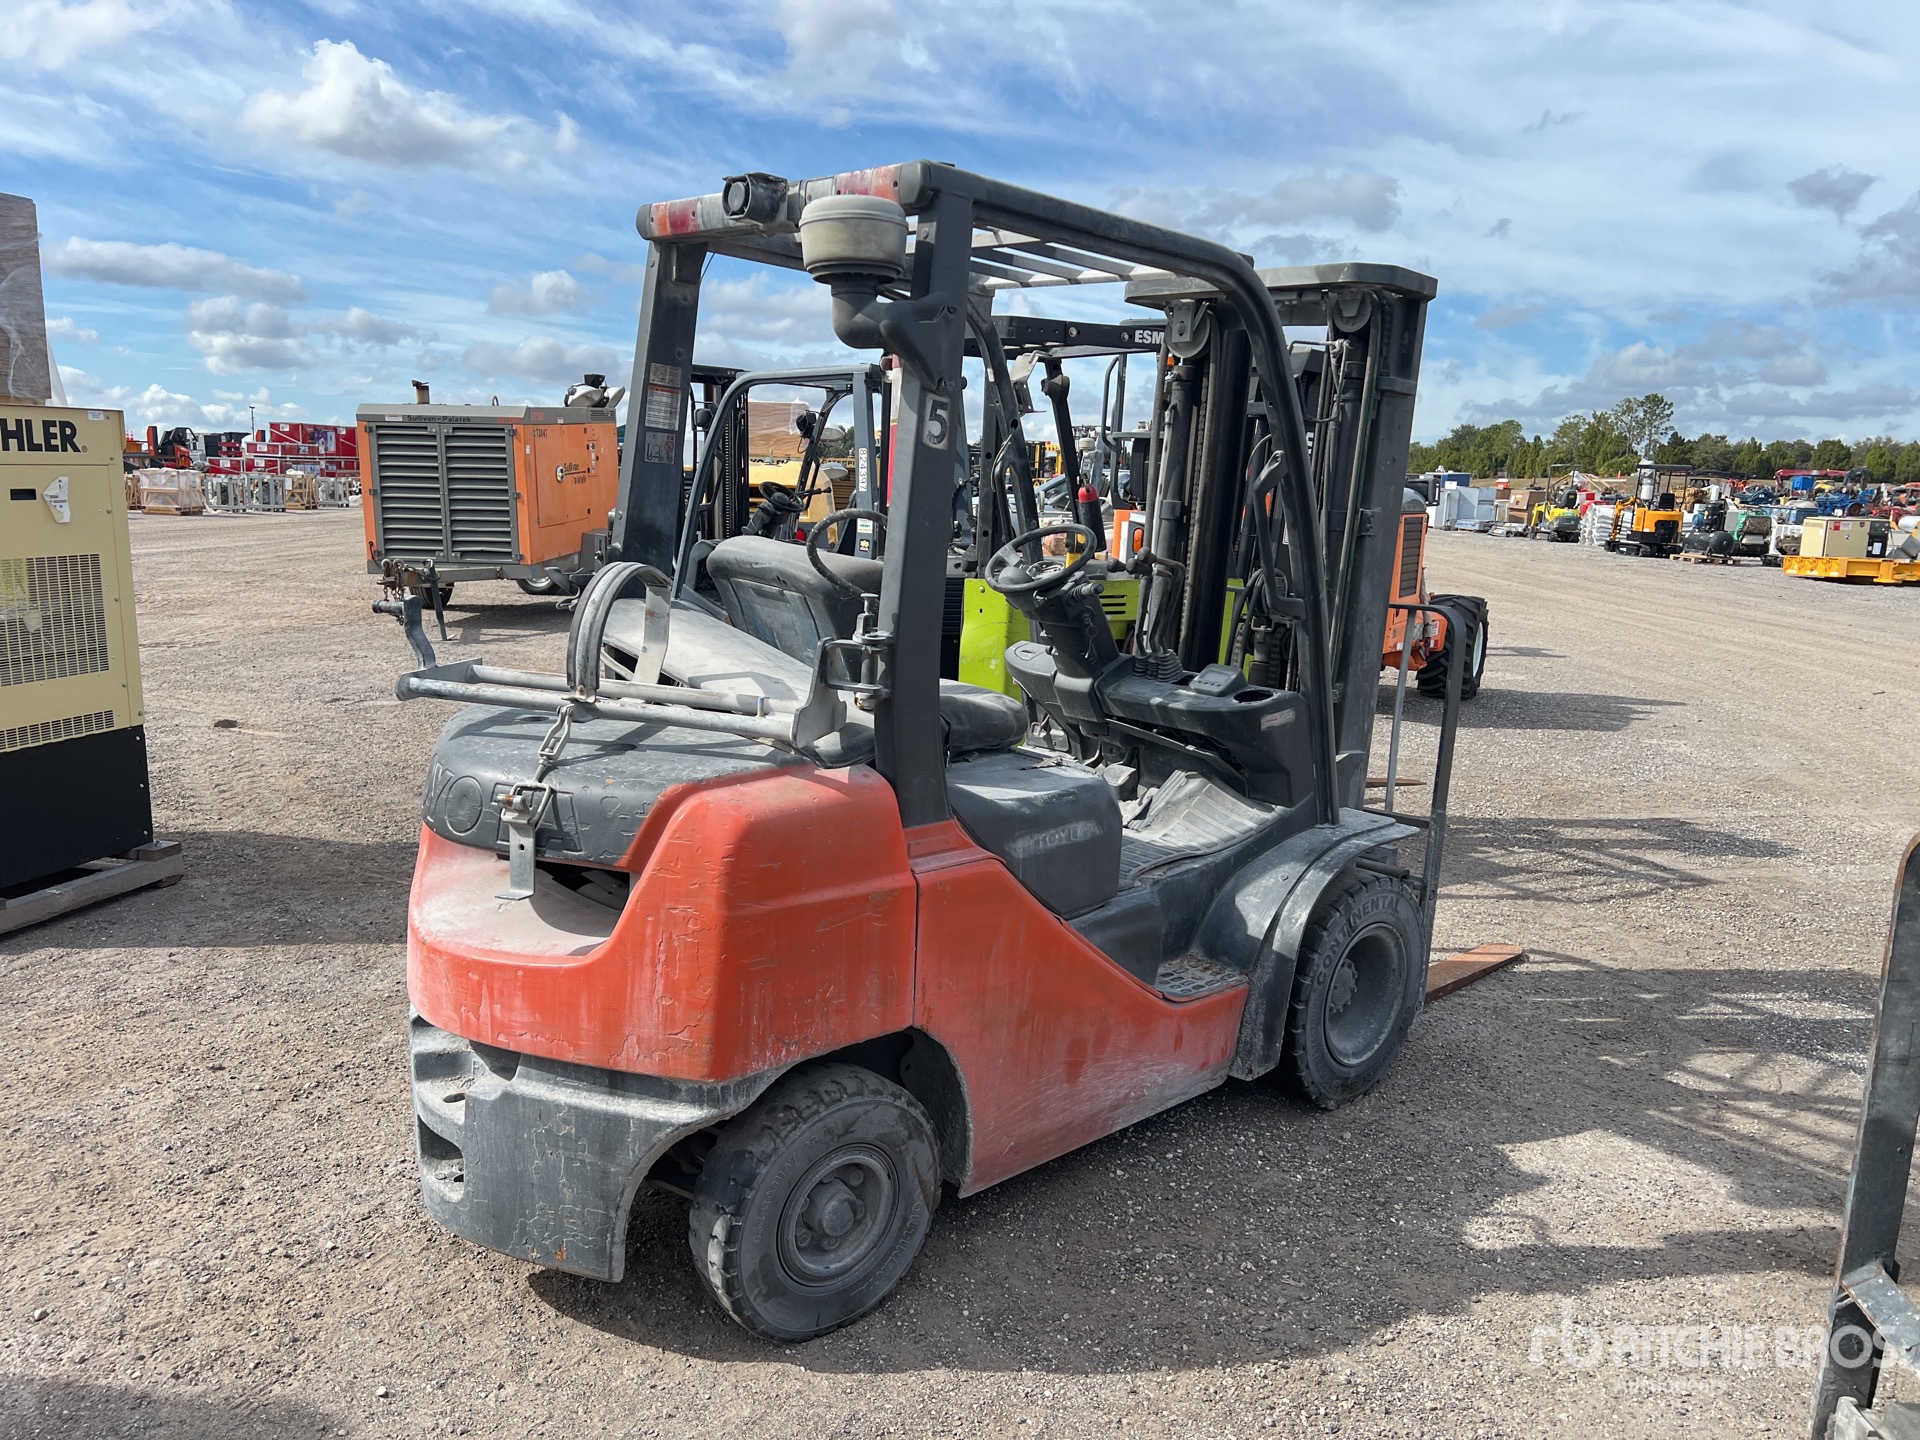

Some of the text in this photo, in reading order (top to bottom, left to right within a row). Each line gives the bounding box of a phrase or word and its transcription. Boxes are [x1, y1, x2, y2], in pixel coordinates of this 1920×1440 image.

[927, 399, 949, 445] 5
[1316, 893, 1401, 986] CONTINENTAL
[849, 1189, 922, 1297] CONTINENTAL
